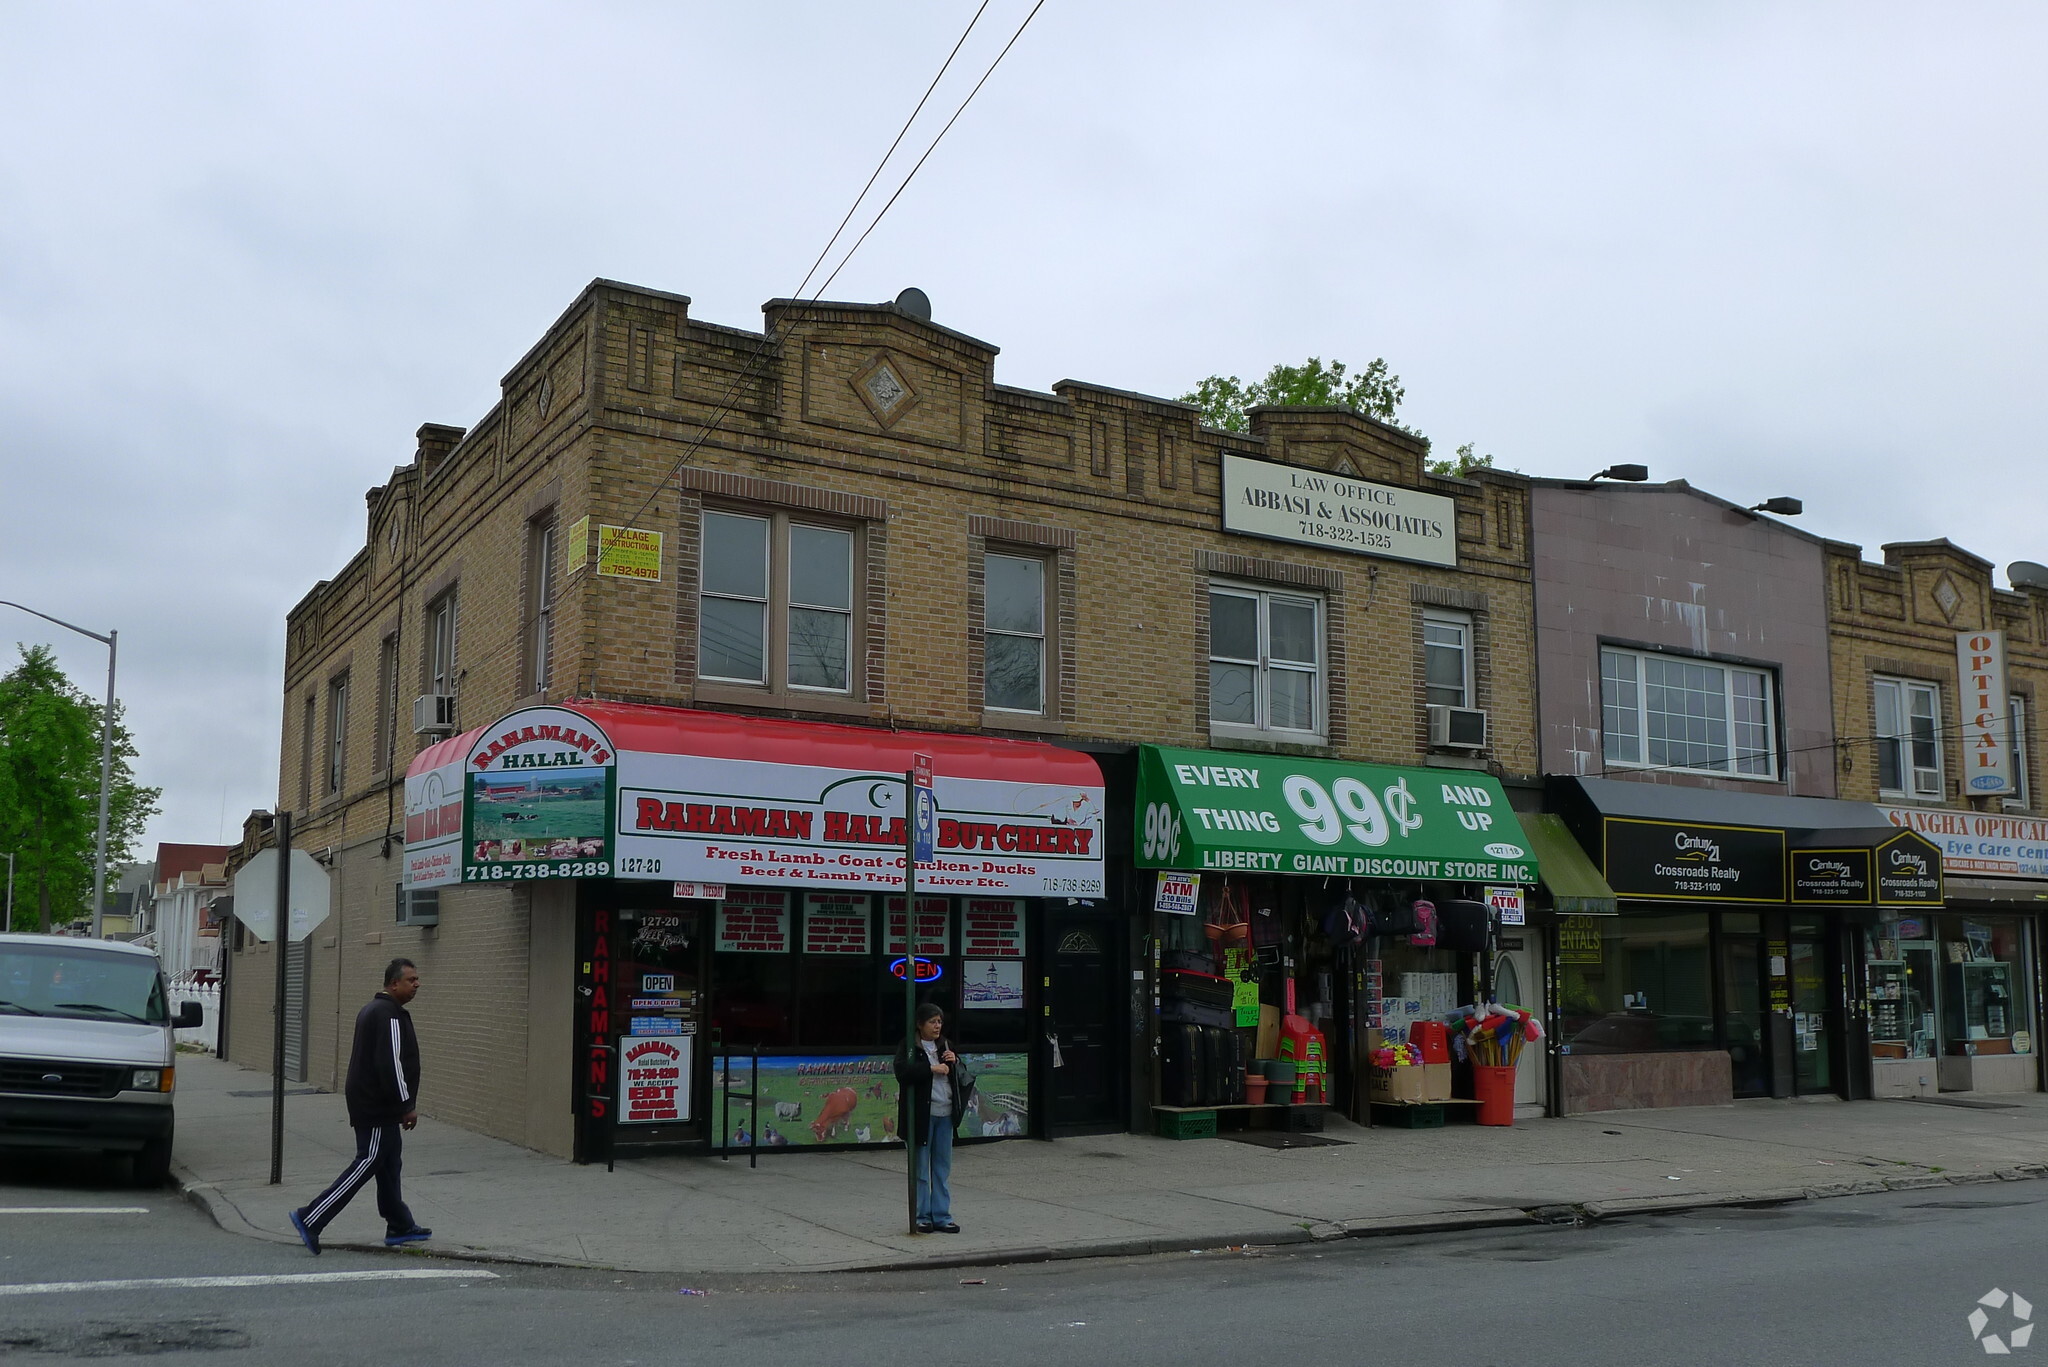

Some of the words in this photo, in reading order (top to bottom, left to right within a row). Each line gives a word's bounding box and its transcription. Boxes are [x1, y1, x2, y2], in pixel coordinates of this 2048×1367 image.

[1291, 474, 1329, 494] LAW
[1334, 482, 1396, 506] OFFICE
[1241, 486, 1311, 516] ABBASI
[1317, 501, 1333, 520] &
[1338, 504, 1443, 539] ASSOCIATES
[611, 528, 650, 542] VILLAGE
[1299, 520, 1392, 549] 718-322-1525
[601, 538, 649, 551] CONSTRUCTION
[1969, 636, 1998, 768] OPTICAL
[472, 725, 611, 770] RAHAMAN'S
[502, 751, 583, 769] HALAL
[915, 766, 931, 778] STANDING
[1174, 764, 1260, 789] EVERY
[1282, 774, 1423, 847] 99¢
[1441, 784, 1492, 807] AND
[636, 797, 813, 841] RAHAMAN
[824, 811, 907, 846] HALA
[937, 818, 1093, 855] BUTCHERY
[1192, 808, 1281, 833] THING
[1456, 810, 1493, 832] UP
[1889, 810, 1969, 836] SANGHA
[1143, 801, 1181, 865] 99¢
[706, 846, 763, 861] Fresh
[1675, 832, 1712, 851] Century
[1708, 845, 1721, 862] 21
[1947, 840, 1973, 855] Eye
[1978, 842, 2011, 856] Care
[621, 858, 661, 873] 127-20
[1203, 850, 1283, 869] LIBERTY
[1293, 854, 1348, 873] GIANT
[1353, 858, 1440, 877] DISCOUNT
[1444, 862, 1497, 879] STORE
[1502, 865, 1533, 881] INC.
[1809, 858, 1843, 871] Century
[1891, 849, 1921, 866] Century
[466, 861, 610, 881] 718-738-8289
[740, 866, 786, 877] Beef
[789, 869, 803, 878] &
[807, 870, 861, 881] Lamb
[929, 876, 973, 886] Liver
[977, 877, 1009, 888] Etc.
[1654, 863, 1709, 878] Crossroads
[1711, 866, 1740, 882] Realty
[675, 883, 695, 897] CLOSED
[702, 884, 724, 898] TUESDAY
[1043, 878, 1101, 893] 718-738-8289
[1162, 881, 1193, 896] ATM
[1675, 881, 1721, 891] 718-323-1100
[1797, 879, 1839, 887] Crossroads
[1841, 880, 1864, 888] Realty
[1880, 877, 1918, 888] Crossroads
[1919, 878, 1938, 889] Realty
[1491, 896, 1519, 908] ATM
[640, 916, 679, 927] 127-20
[1578, 916, 1593, 929] DO
[1560, 930, 1600, 950] ENTALS
[893, 963, 937, 977] OEN
[645, 976, 672, 990] OPEN
[628, 1086, 678, 1100] EBT
